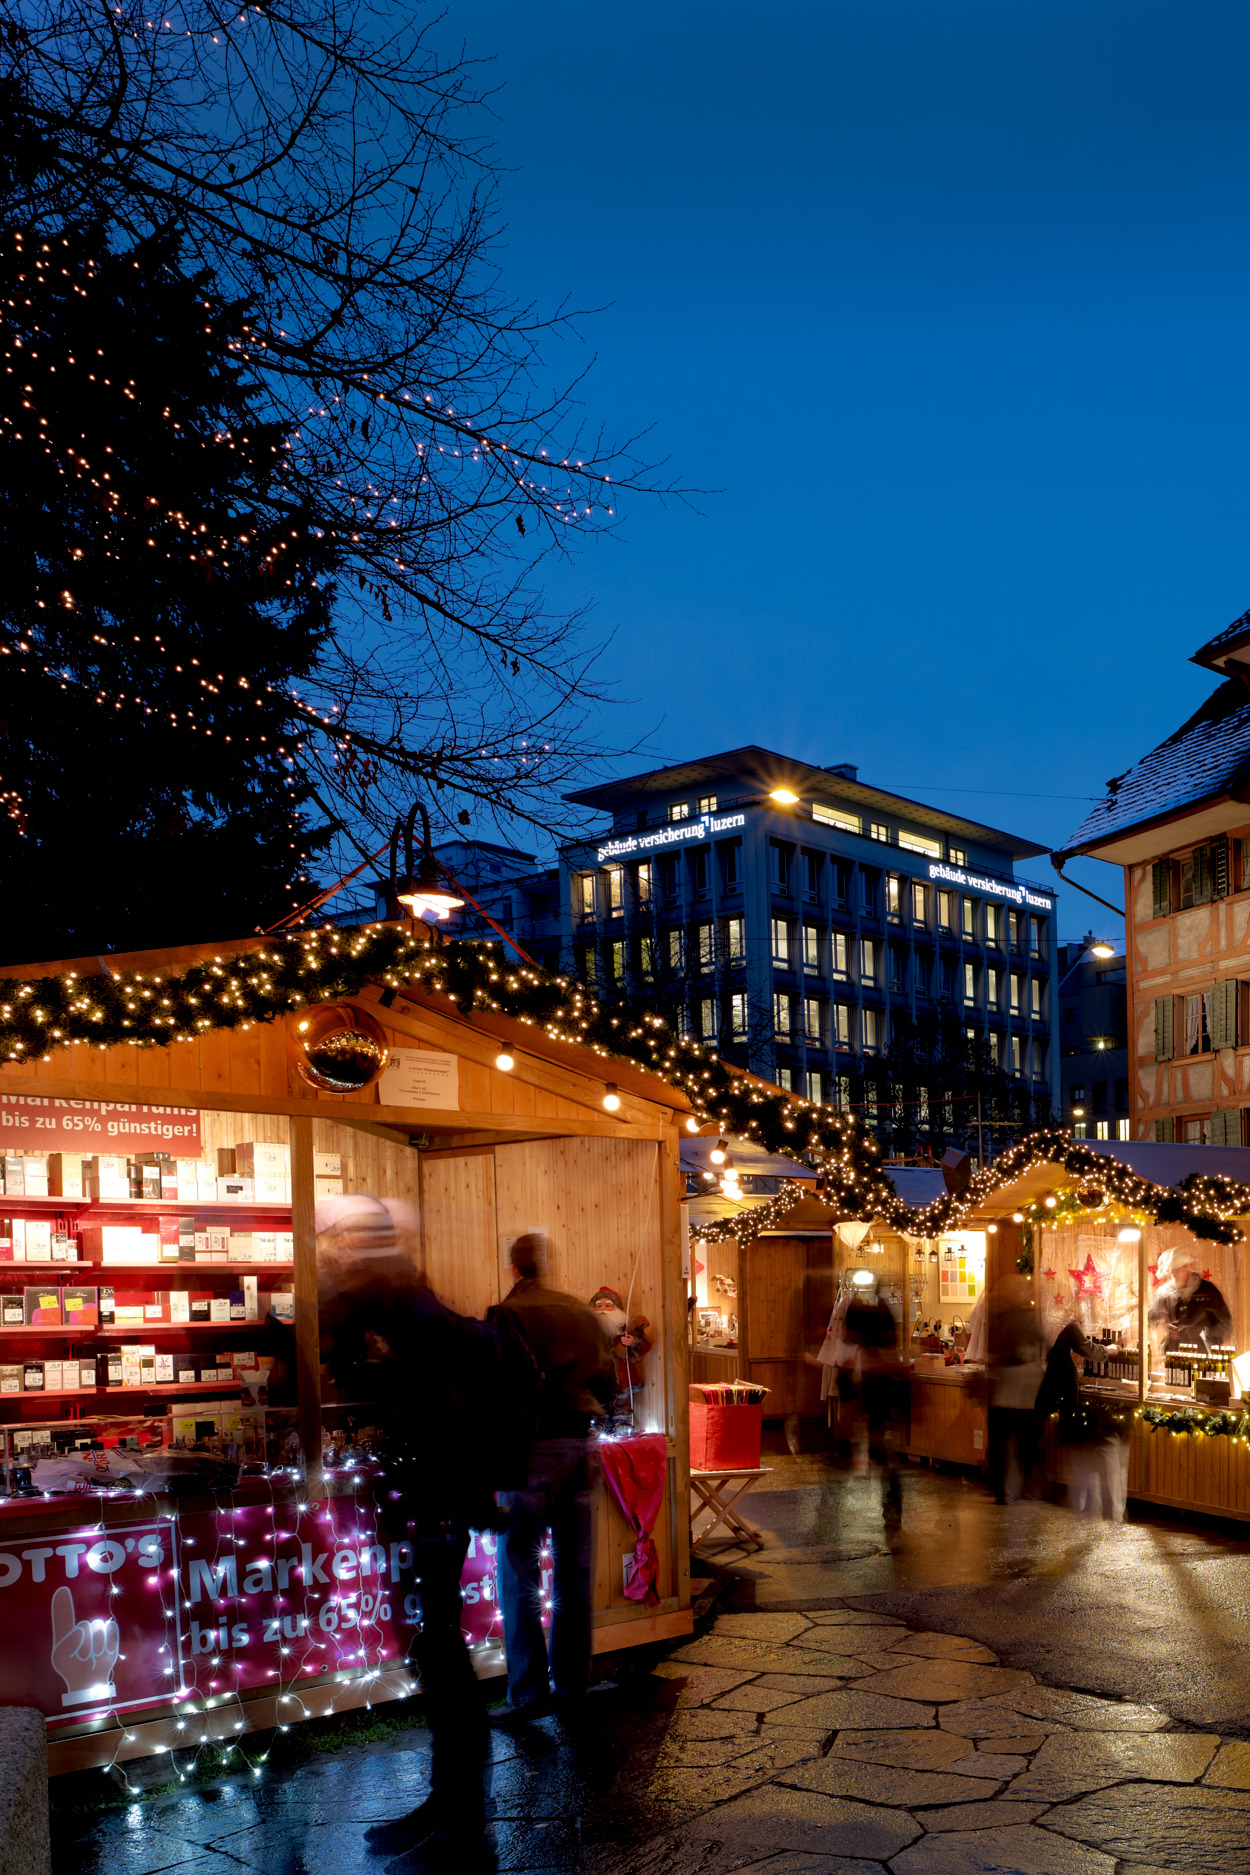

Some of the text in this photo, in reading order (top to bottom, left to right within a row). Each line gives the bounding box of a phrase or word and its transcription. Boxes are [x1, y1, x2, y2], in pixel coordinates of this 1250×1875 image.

[597, 814, 745, 862] gebäude versicherung luzern
[929, 864, 1052, 909] gebäude versicherung luzern
[1, 1111, 197, 1139] bis zu 65% günstiger!
[191, 1616, 250, 1655] bis
[263, 1613, 306, 1642] zu
[318, 1591, 392, 1633] 65%
